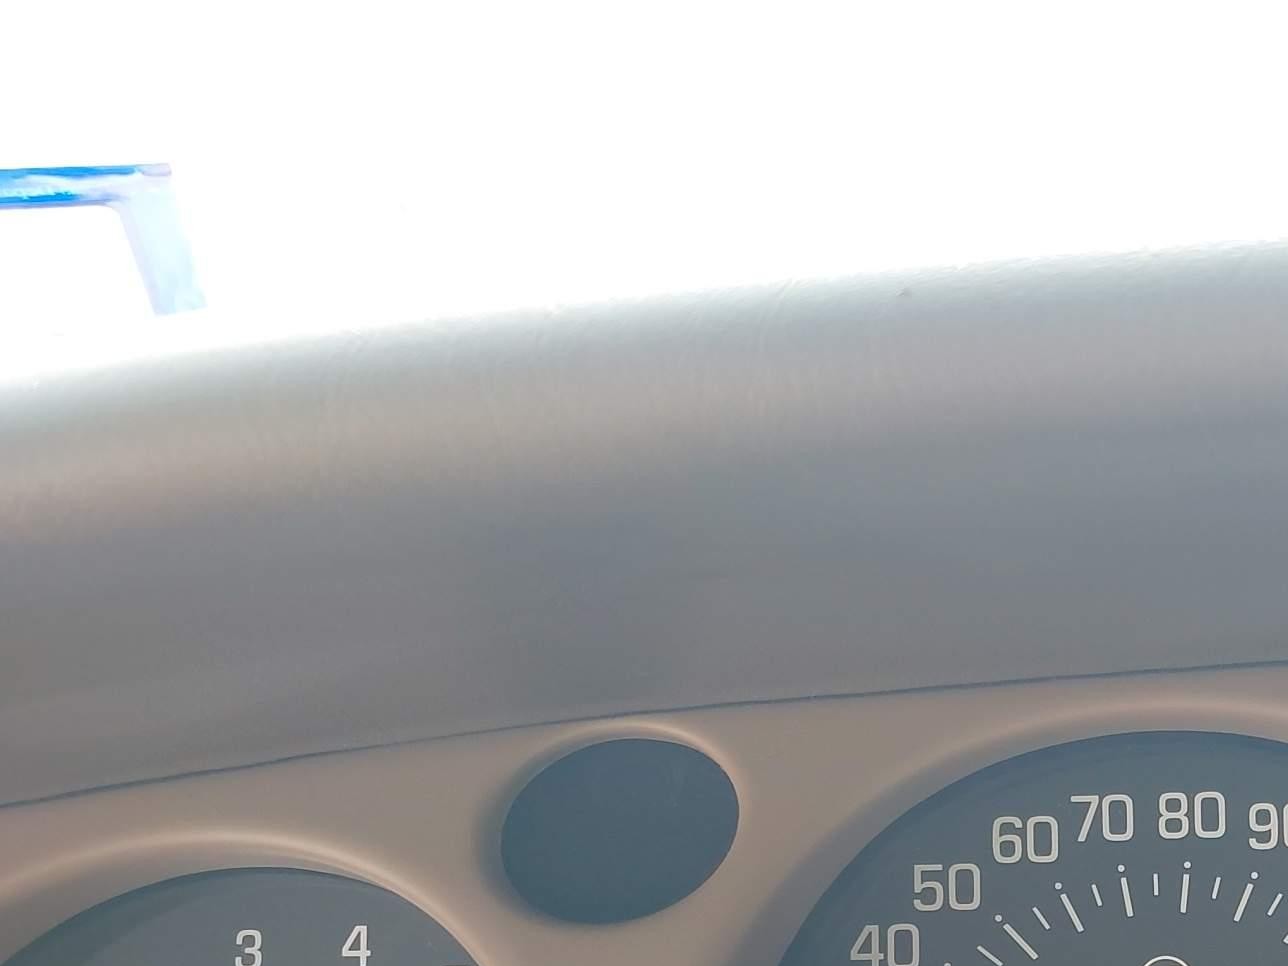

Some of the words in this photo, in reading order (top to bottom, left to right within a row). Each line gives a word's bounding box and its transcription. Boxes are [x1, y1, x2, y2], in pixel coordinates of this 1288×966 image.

[1071, 795, 1133, 841] 70
[1159, 792, 1225, 838] 80
[993, 816, 1058, 863] 60
[914, 864, 980, 911] 50
[342, 926, 371, 966] 4
